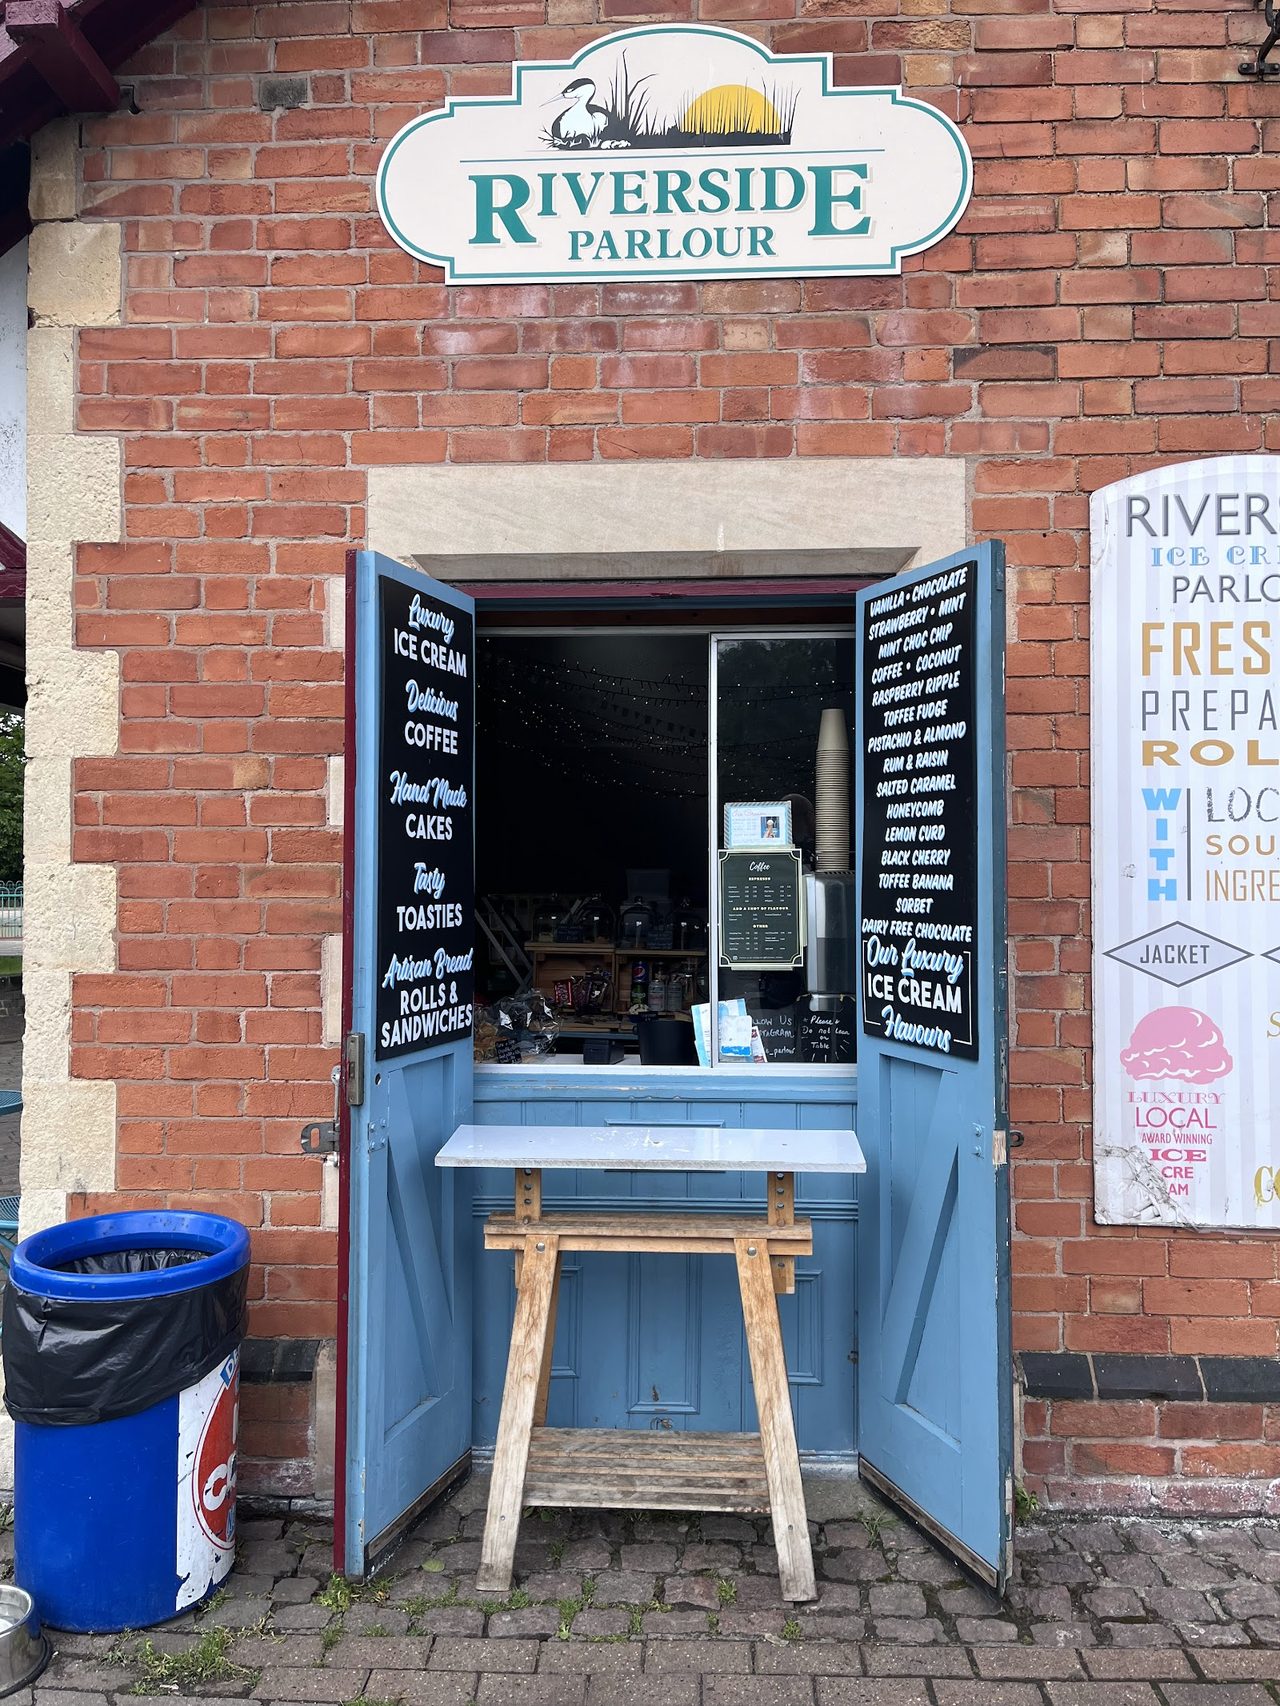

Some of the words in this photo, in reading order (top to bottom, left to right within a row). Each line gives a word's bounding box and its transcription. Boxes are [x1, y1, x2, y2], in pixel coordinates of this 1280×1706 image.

[468, 163, 874, 246] RIVERSIDE
[568, 226, 778, 261] PARLOUR
[1125, 493, 1280, 537] RIVER
[1151, 546, 1210, 567] ICE
[1226, 545, 1280, 565] CR
[869, 590, 904, 618] VANILLA
[912, 567, 968, 603] CHOCOLATE
[408, 593, 454, 644] Luxury
[868, 605, 929, 641] STRAWBERRY
[938, 593, 967, 618] MINT
[394, 627, 418, 661] ICE
[420, 639, 467, 678] CREAM
[878, 638, 902, 660] MINT
[903, 630, 929, 653] CHOC
[929, 622, 953, 645] CHIP
[1141, 620, 1271, 676] FRES
[871, 661, 903, 685] COFFEE
[915, 645, 962, 673] COCONUT
[405, 679, 458, 722] Delicious
[872, 680, 924, 707] RASPBERRY
[925, 670, 961, 694] RIPPLE
[883, 706, 915, 728] TOFFEE
[916, 699, 948, 721] FUDGE
[1141, 689, 1278, 732] PREPA
[404, 720, 458, 755] COFFEE
[867, 731, 912, 753] PISTACHIO
[913, 729, 922, 745] &
[923, 721, 967, 743] ALMOND
[1142, 739, 1280, 767] ROL
[883, 756, 904, 774] RUM
[906, 753, 914, 771] &
[915, 750, 949, 769] RAISIN
[389, 770, 430, 806] Hand
[431, 777, 467, 810] Made
[876, 778, 908, 798] SALTED
[910, 774, 956, 794] CARAMEL
[886, 799, 944, 820] HONEYCOMB
[1206, 786, 1280, 823] LOC
[405, 813, 453, 840] CAKES
[885, 826, 917, 842] LEMON
[918, 825, 946, 841] CURD
[881, 849, 911, 866] BLACK
[912, 849, 951, 866] CHERRY
[1141, 788, 1182, 901] WITH
[1206, 834, 1275, 856] SOU
[413, 862, 445, 899] Tasty
[749, 861, 771, 872] Coffee
[878, 873, 911, 889] TOFFEE
[912, 873, 954, 891] BANANA
[397, 903, 463, 932] TOASTIES
[895, 898, 934, 914] SORBET
[861, 918, 889, 935] DAIRY
[890, 920, 913, 937] FREE
[915, 923, 972, 943] CHOCOLATE
[382, 953, 433, 989] Artisan
[434, 948, 474, 980] Bread
[866, 934, 899, 968] Our
[901, 938, 964, 984] Luxury
[1140, 945, 1210, 964] JACKET
[400, 982, 446, 1016] ROLLS
[449, 981, 458, 1004] &
[868, 973, 894, 1001] ICE
[898, 978, 962, 1014] CREAM
[381, 1003, 473, 1048] SANDWICHES
[881, 1004, 952, 1053] Flavours
[1126, 1091, 1227, 1105] LUXURY
[1135, 1107, 1217, 1129] LOCAL
[1141, 1132, 1171, 1144] AWARD
[1174, 1133, 1213, 1145] WINNING
[1150, 1149, 1207, 1162] ICE
[1161, 1166, 1194, 1179] CRE
[1168, 1184, 1189, 1196] AM
